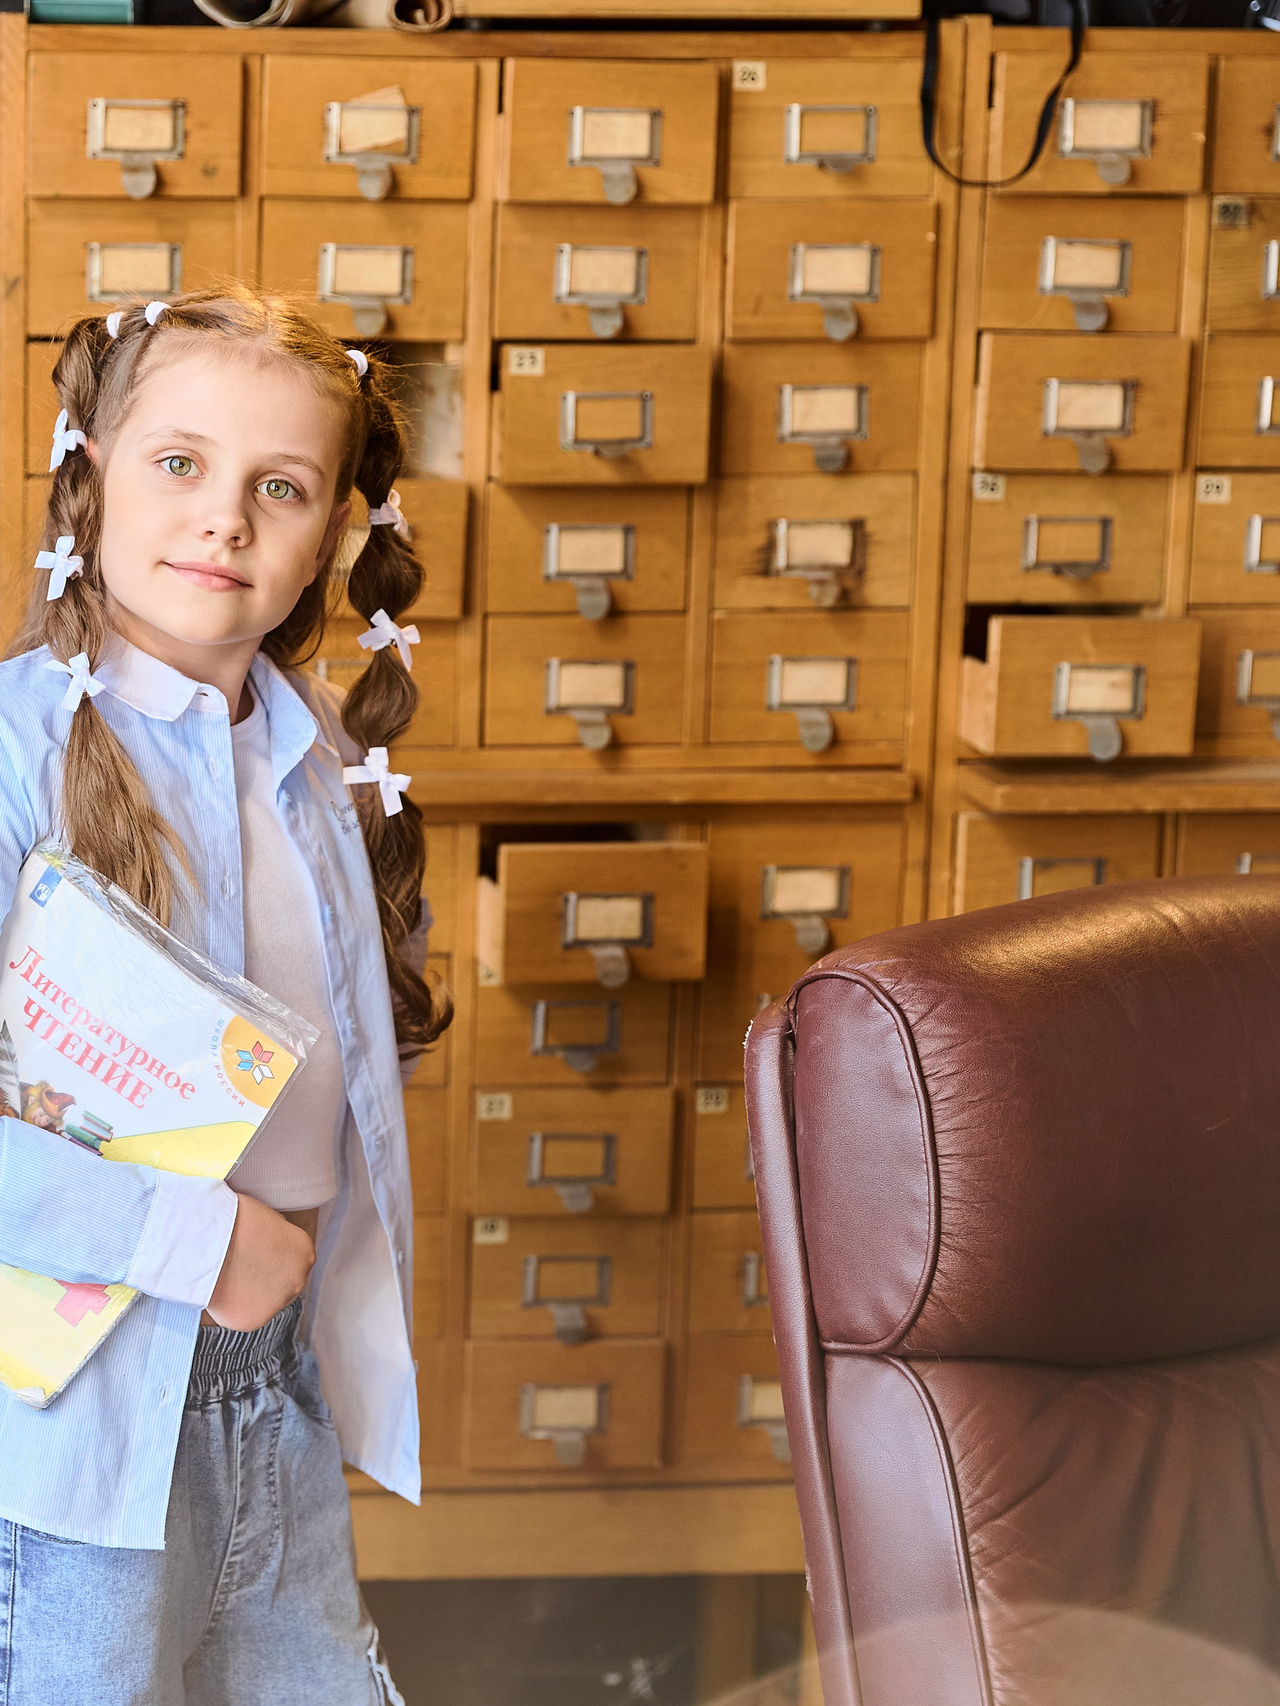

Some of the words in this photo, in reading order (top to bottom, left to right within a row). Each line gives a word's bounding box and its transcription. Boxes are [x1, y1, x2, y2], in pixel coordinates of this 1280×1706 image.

[9, 945, 196, 1100] Литературное
[23, 996, 153, 1110] ЧТЕНИЕ
[214, 1064, 245, 1106] РОССИИ
